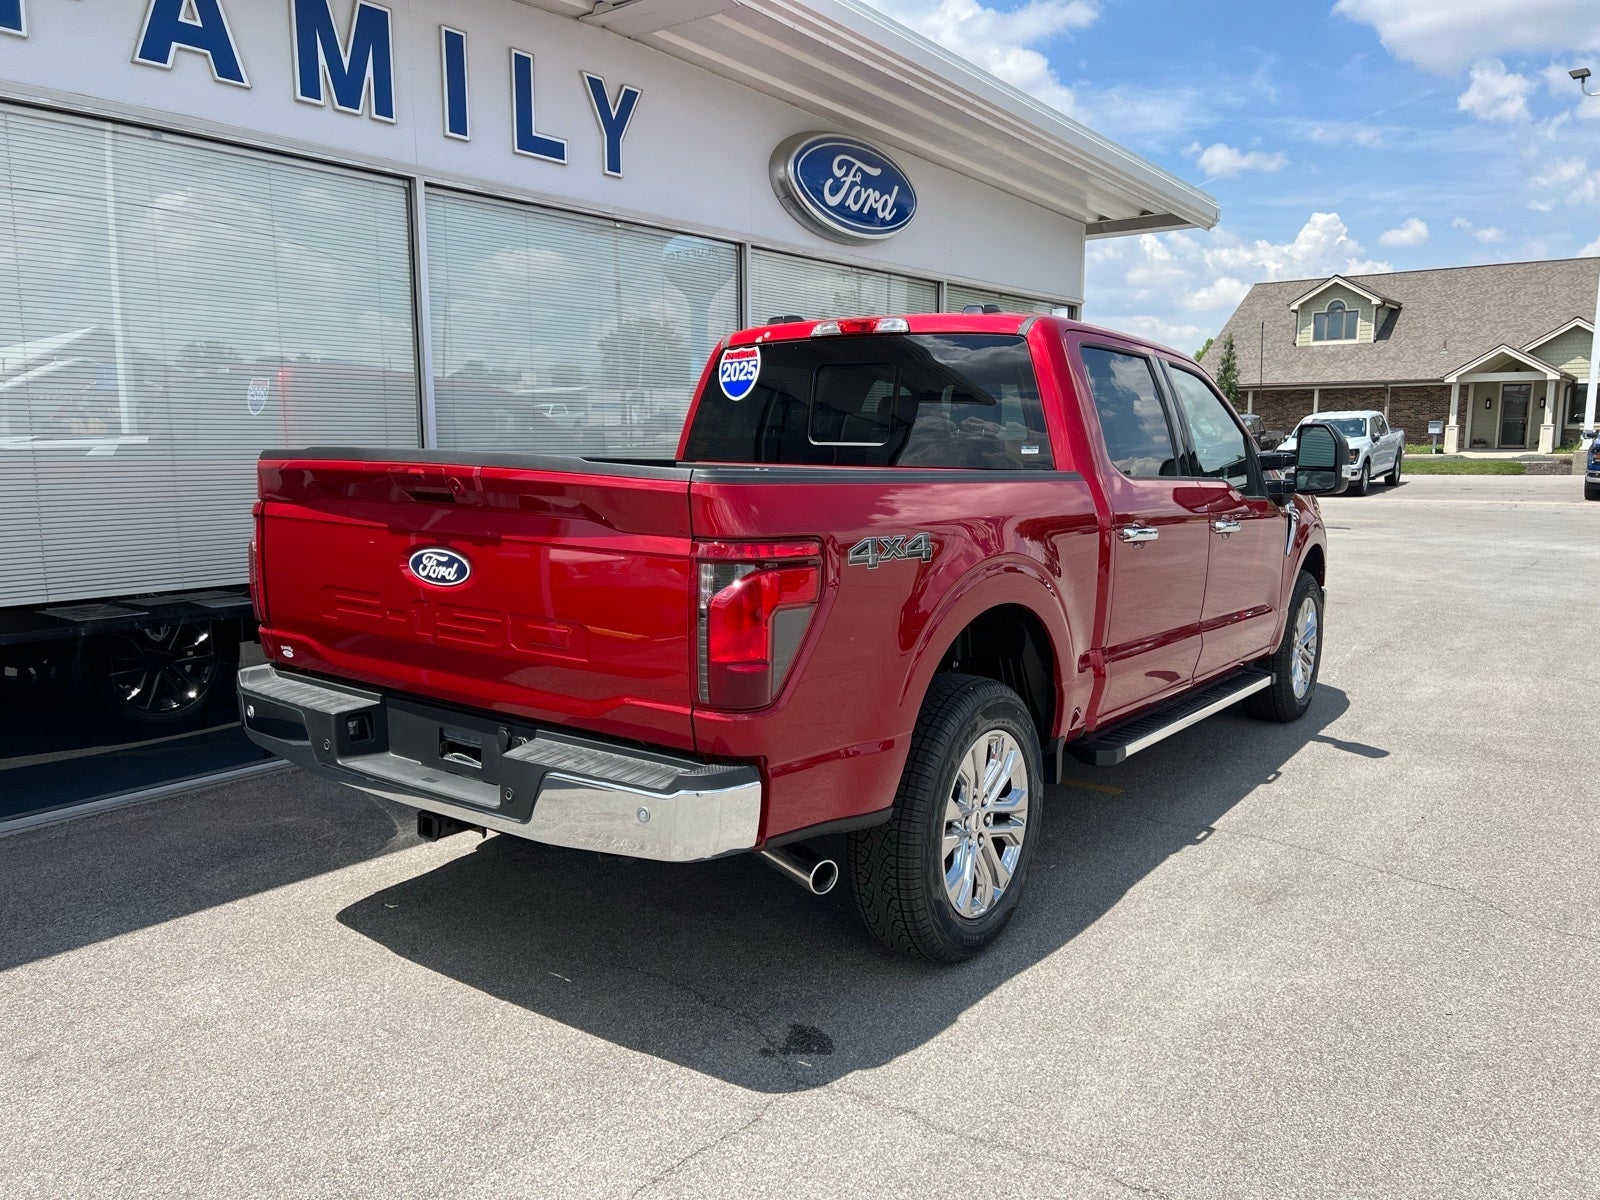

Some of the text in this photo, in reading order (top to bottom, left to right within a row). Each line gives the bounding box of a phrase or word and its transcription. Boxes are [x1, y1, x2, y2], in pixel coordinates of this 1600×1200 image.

[0, 0, 643, 178] AMILY
[823, 154, 899, 222] Ford
[721, 360, 757, 382] 2025
[418, 552, 459, 581] Ford
